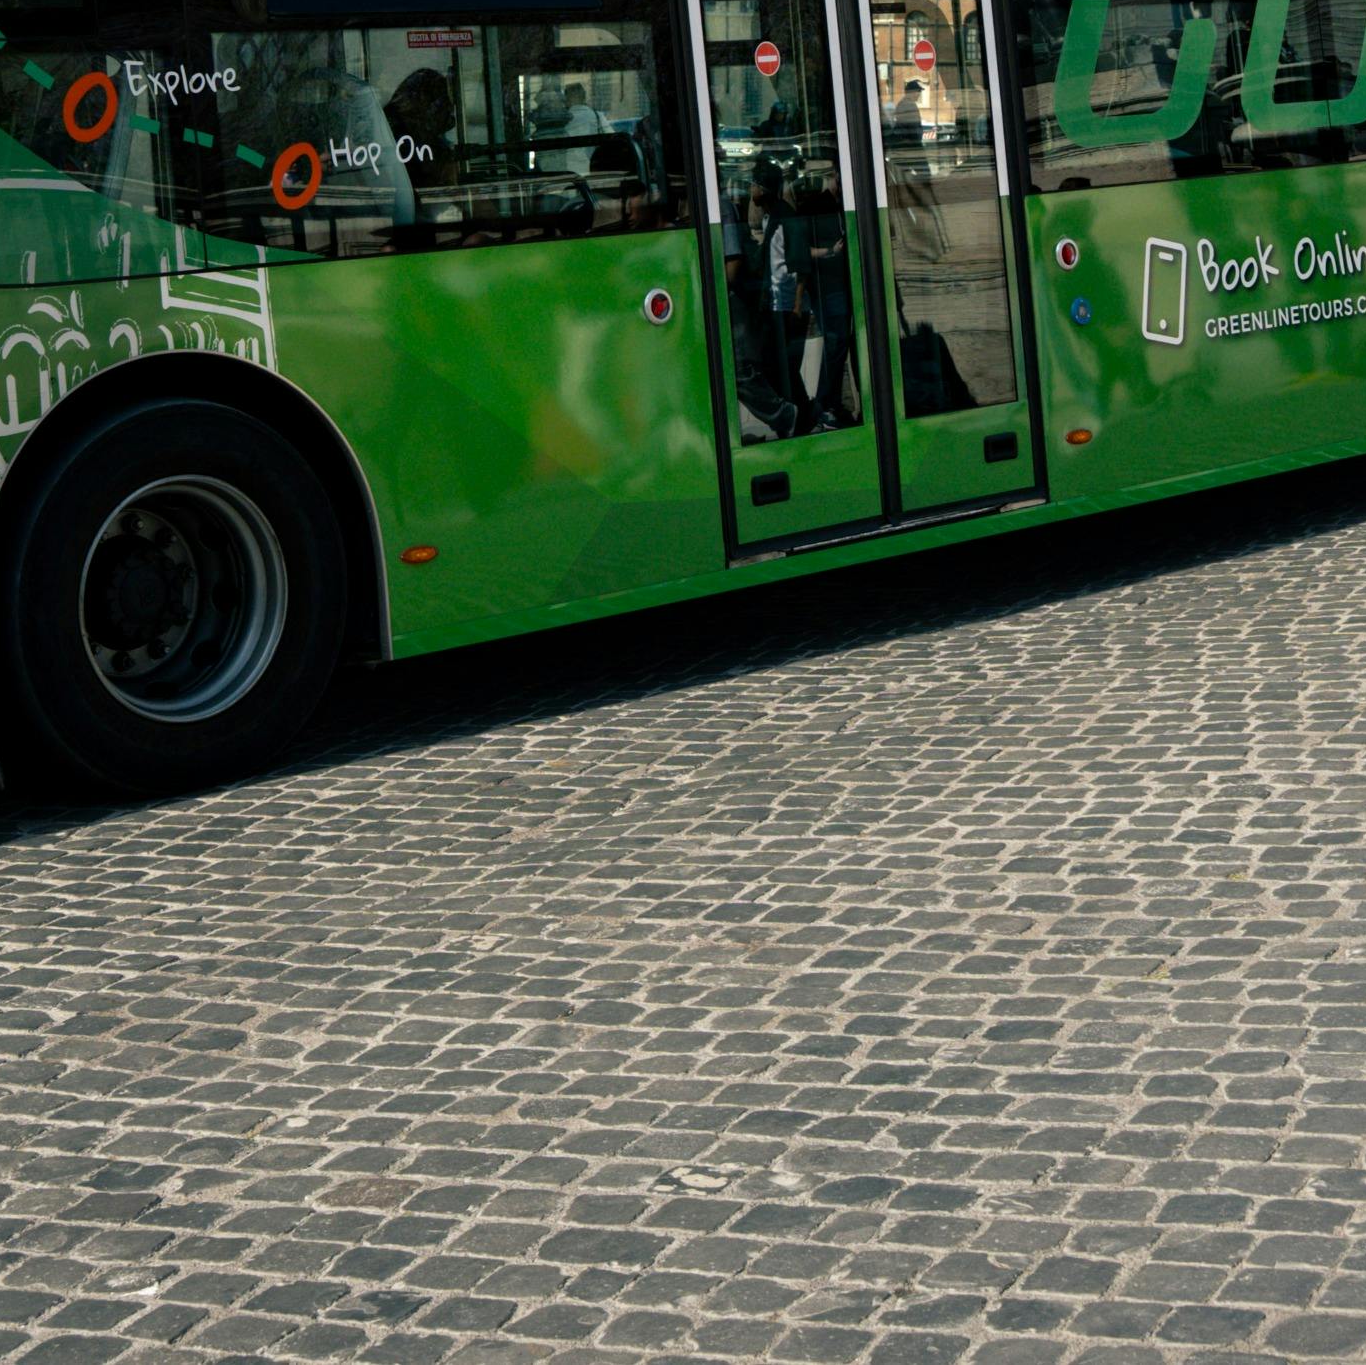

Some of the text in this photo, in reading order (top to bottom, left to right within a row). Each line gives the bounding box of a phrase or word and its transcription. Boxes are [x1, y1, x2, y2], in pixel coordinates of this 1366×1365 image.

[123, 59, 242, 107] Explore
[329, 135, 434, 176] Hop On
[1196, 235, 1280, 292] Book
